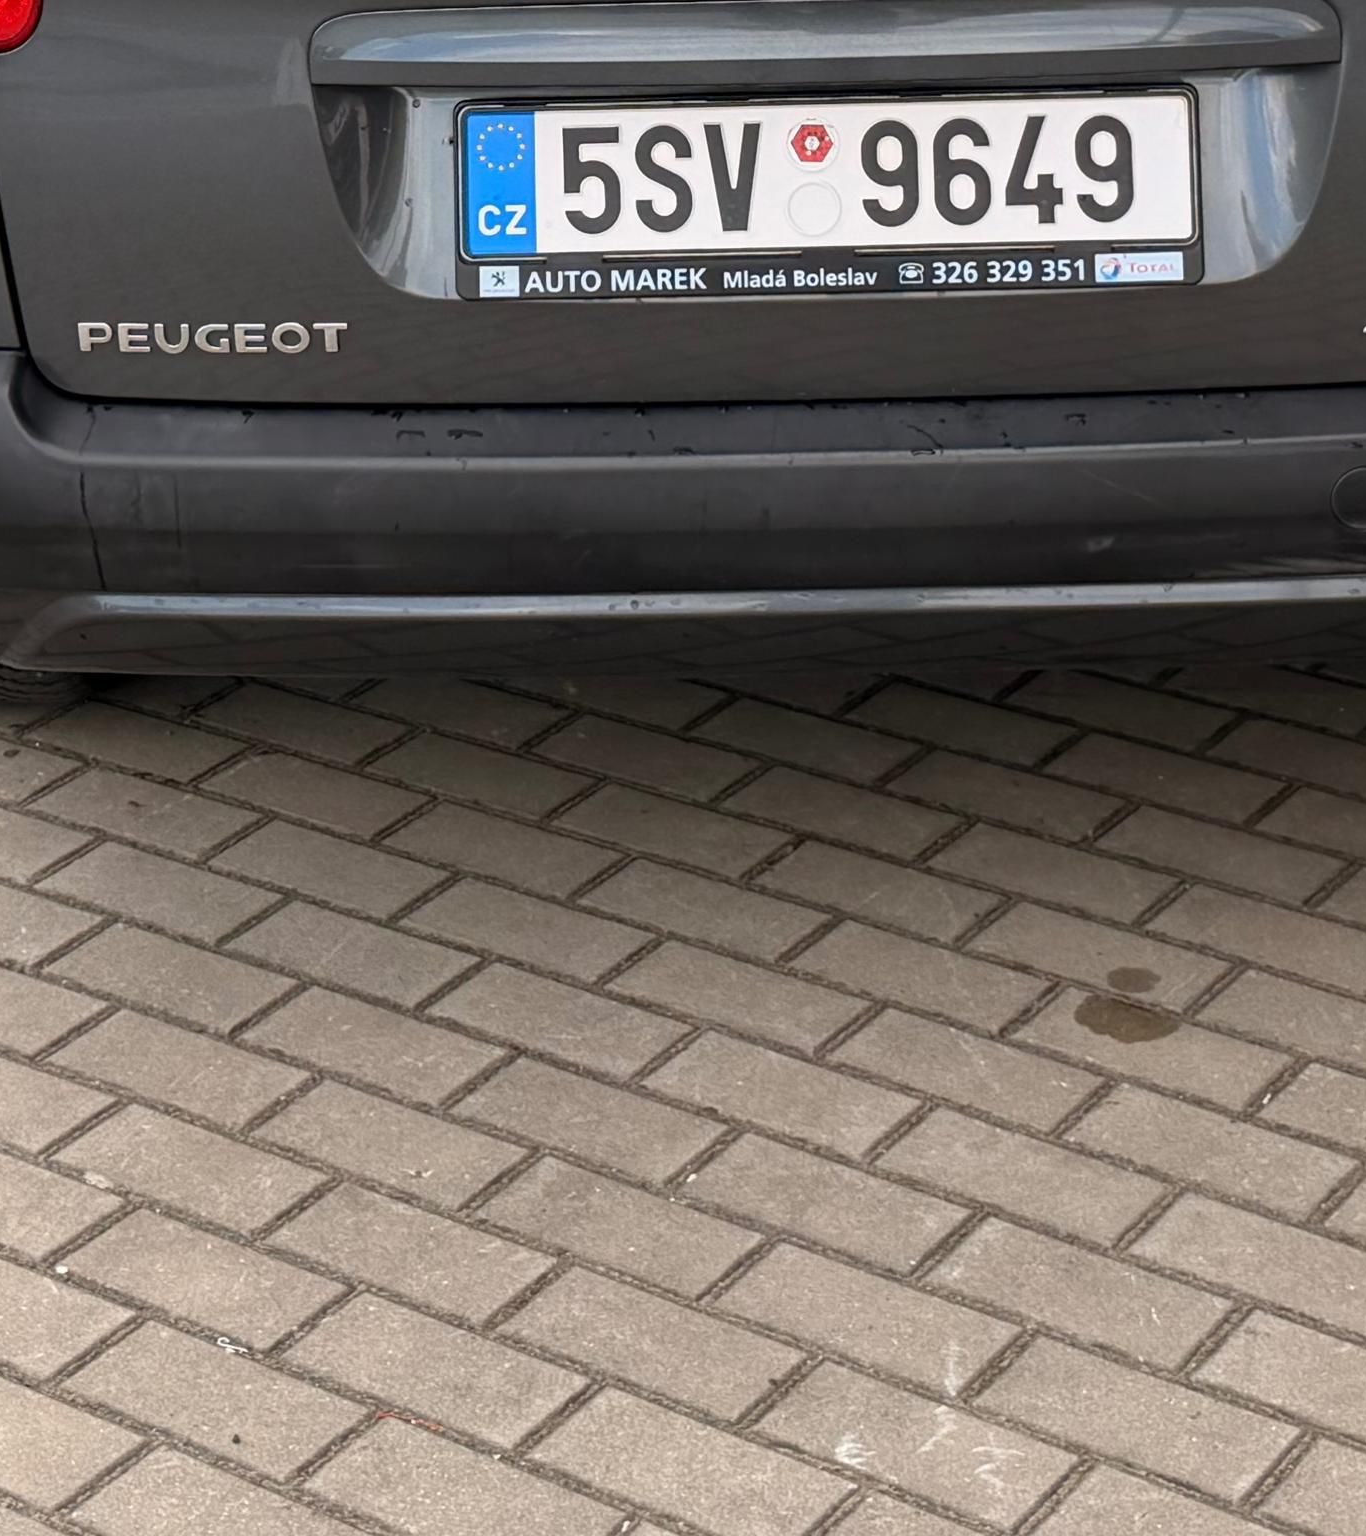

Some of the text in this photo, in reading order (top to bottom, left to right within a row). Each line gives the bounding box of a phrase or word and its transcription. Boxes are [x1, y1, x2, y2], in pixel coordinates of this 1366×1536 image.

[563, 114, 1136, 235] 5SV 9649
[477, 203, 529, 238] CZ
[524, 259, 1086, 293] AUTO MAREK Mladá Boleslav 326 329 351
[77, 321, 348, 354] PEUGEOT
